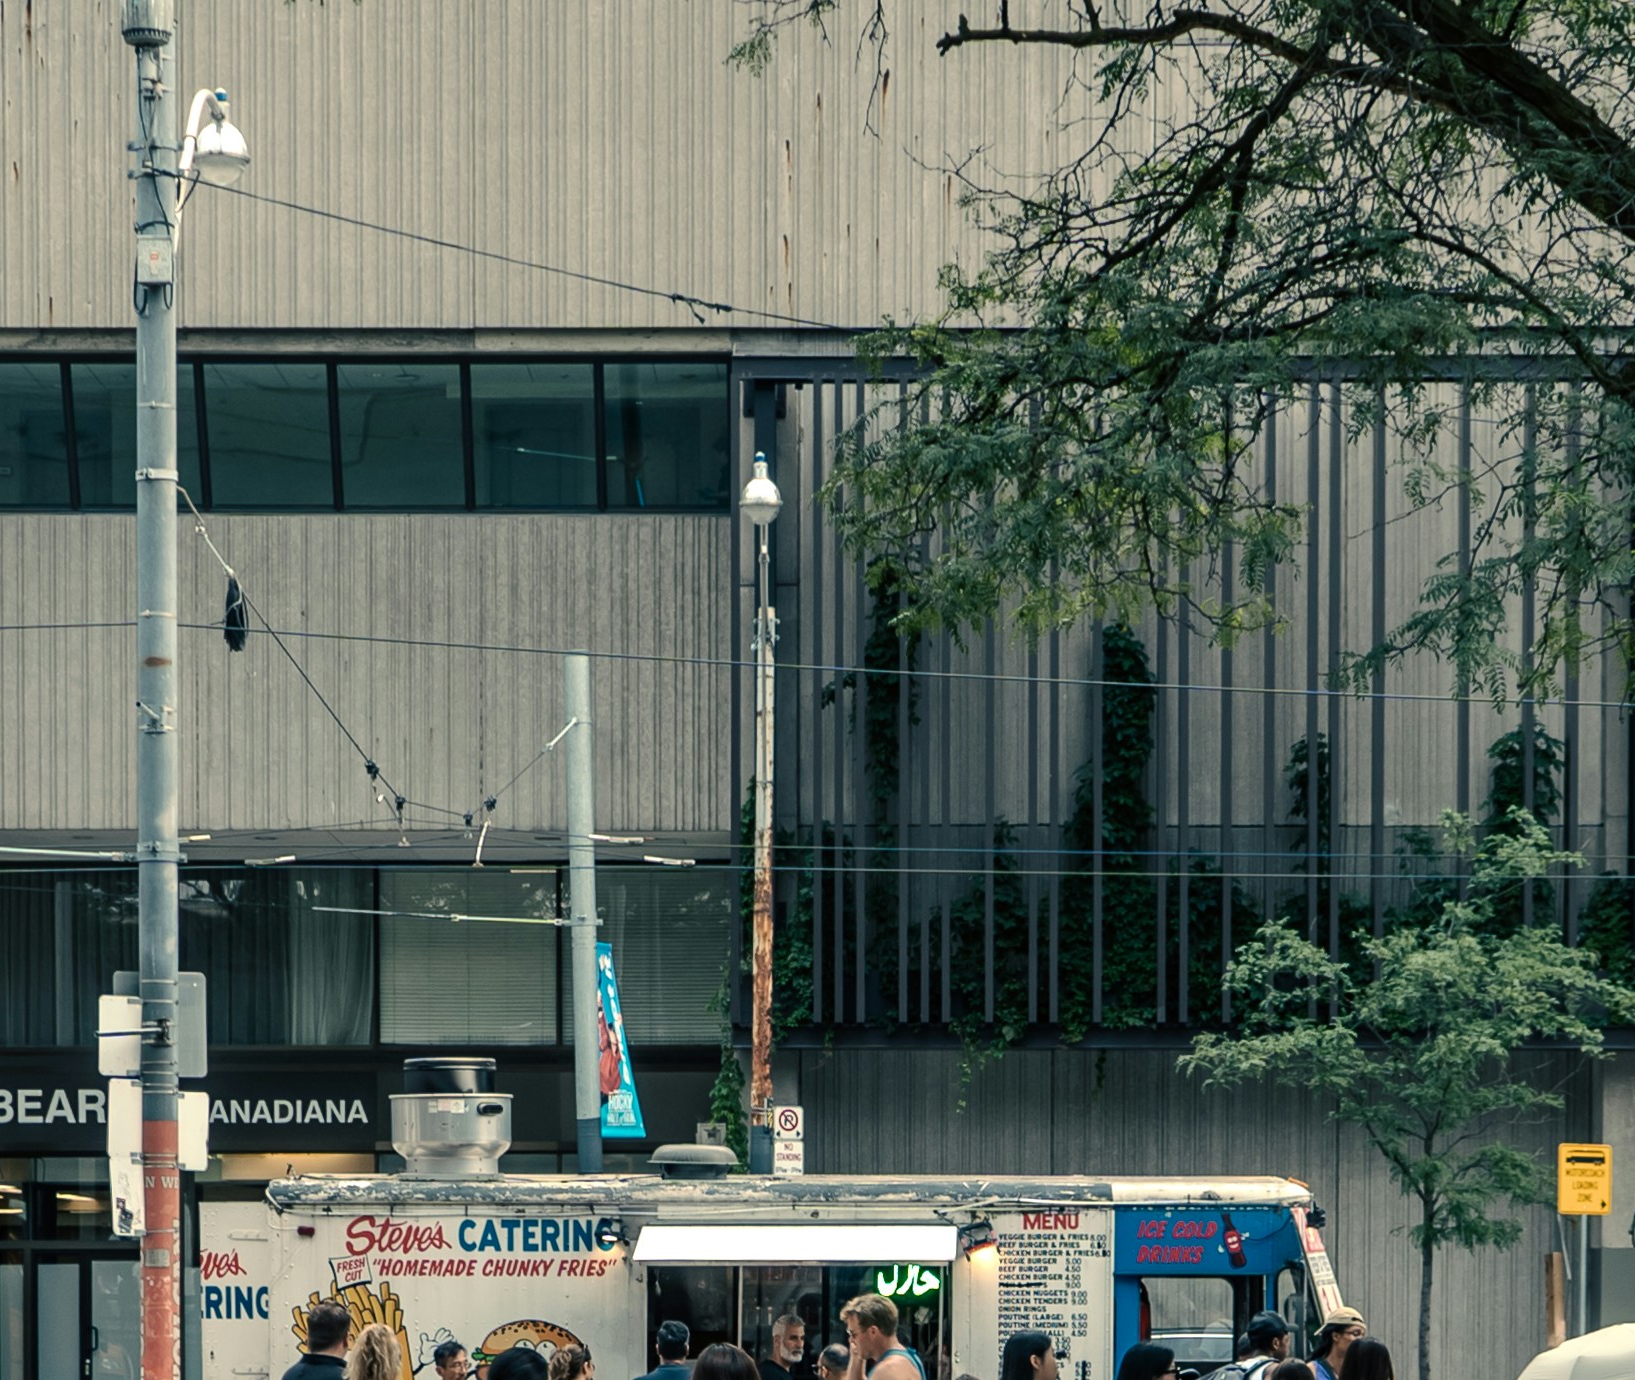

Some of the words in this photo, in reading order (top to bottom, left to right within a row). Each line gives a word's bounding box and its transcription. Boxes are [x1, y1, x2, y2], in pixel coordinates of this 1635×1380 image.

[209, 1099, 369, 1124] ANADIANA
[1023, 1213, 1079, 1230] MENU
[1137, 1220, 1168, 1239] ICE
[1172, 1220, 1218, 1239] COLD
[345, 1215, 453, 1256] Steve's
[1137, 1245, 1204, 1264] DRINKS
[337, 1257, 366, 1273] FRESH
[373, 1257, 478, 1277] "HOMEMADE
[482, 1258, 555, 1277] CHUNKY
[557, 1258, 617, 1277] FRIES"
[345, 1269, 363, 1283] CUT
[200, 1285, 269, 1320] RING
